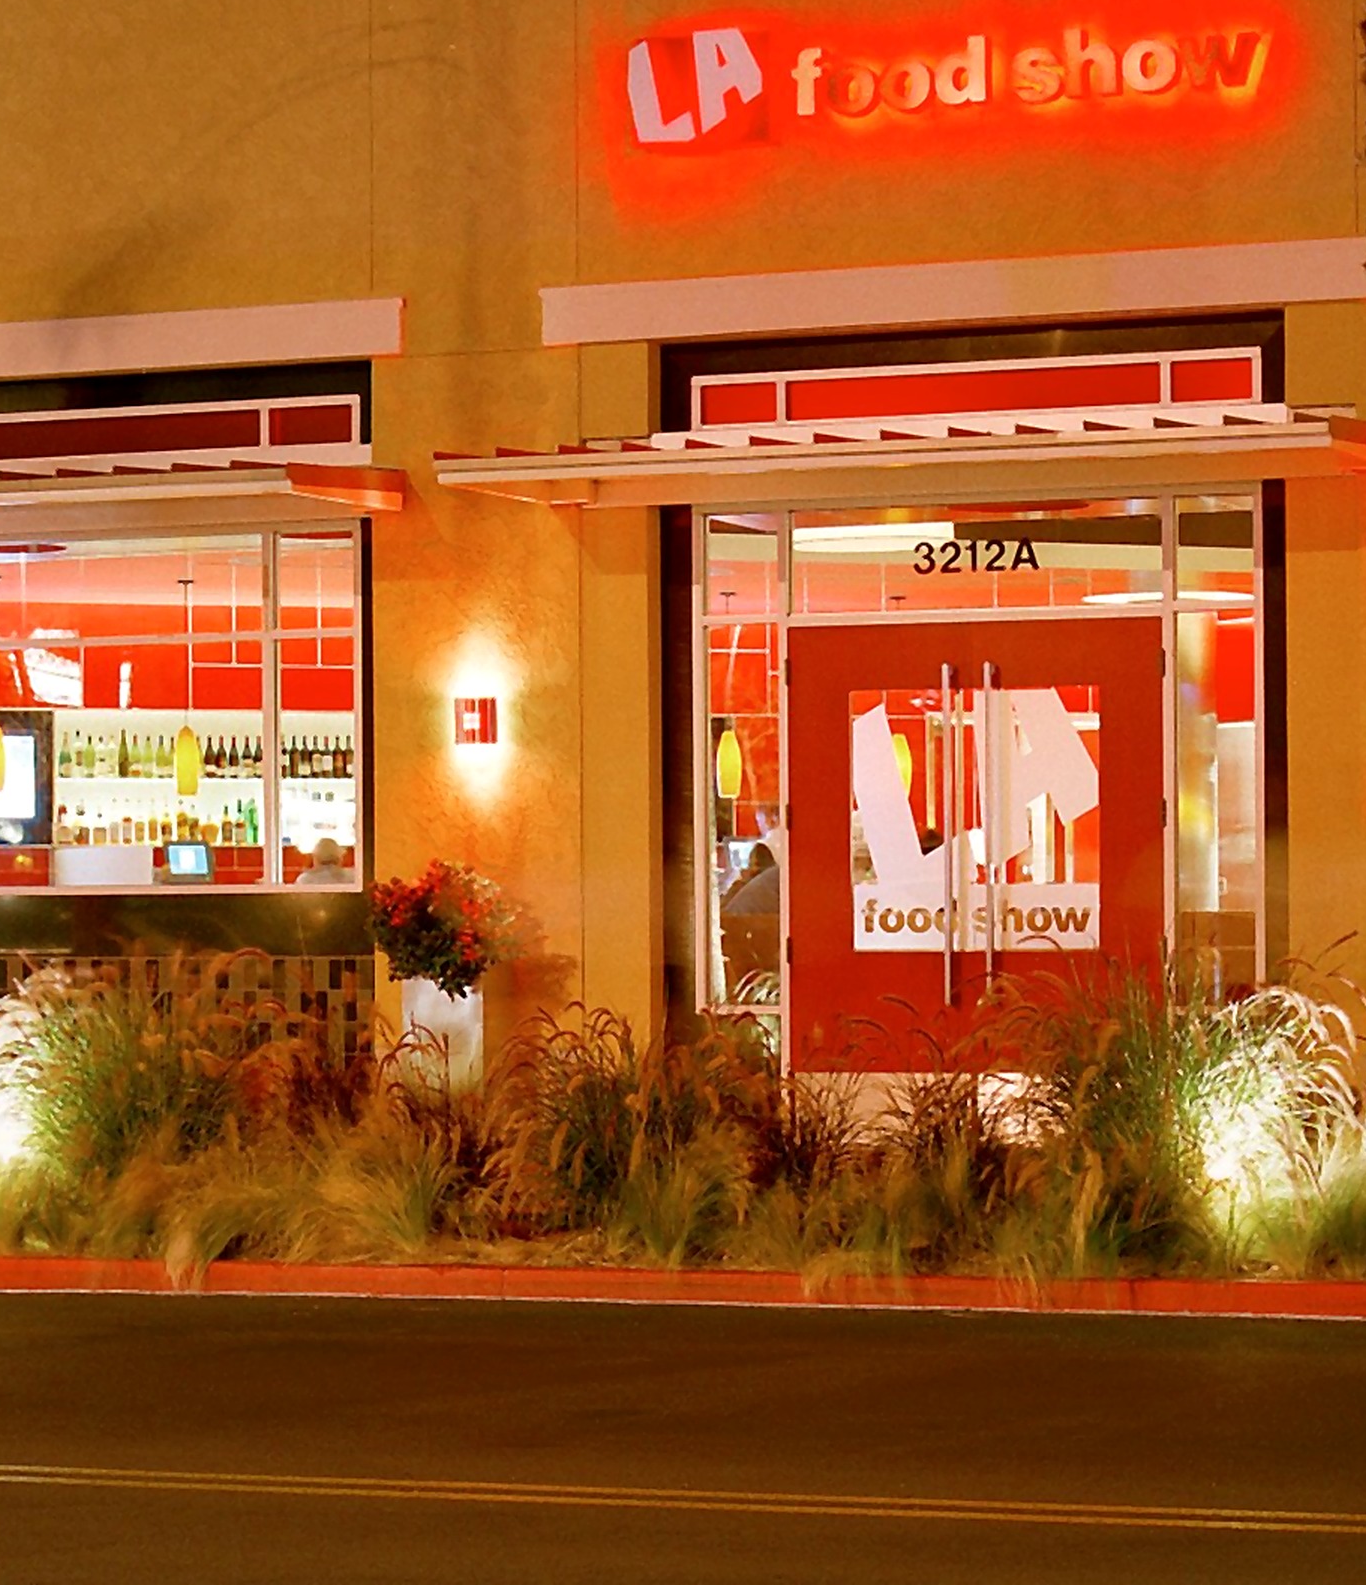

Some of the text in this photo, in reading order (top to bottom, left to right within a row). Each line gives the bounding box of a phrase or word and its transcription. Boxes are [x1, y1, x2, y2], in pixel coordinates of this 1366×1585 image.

[627, 26, 1271, 143] LA food show
[913, 536, 1040, 575] 3212A
[852, 686, 1100, 884] LA
